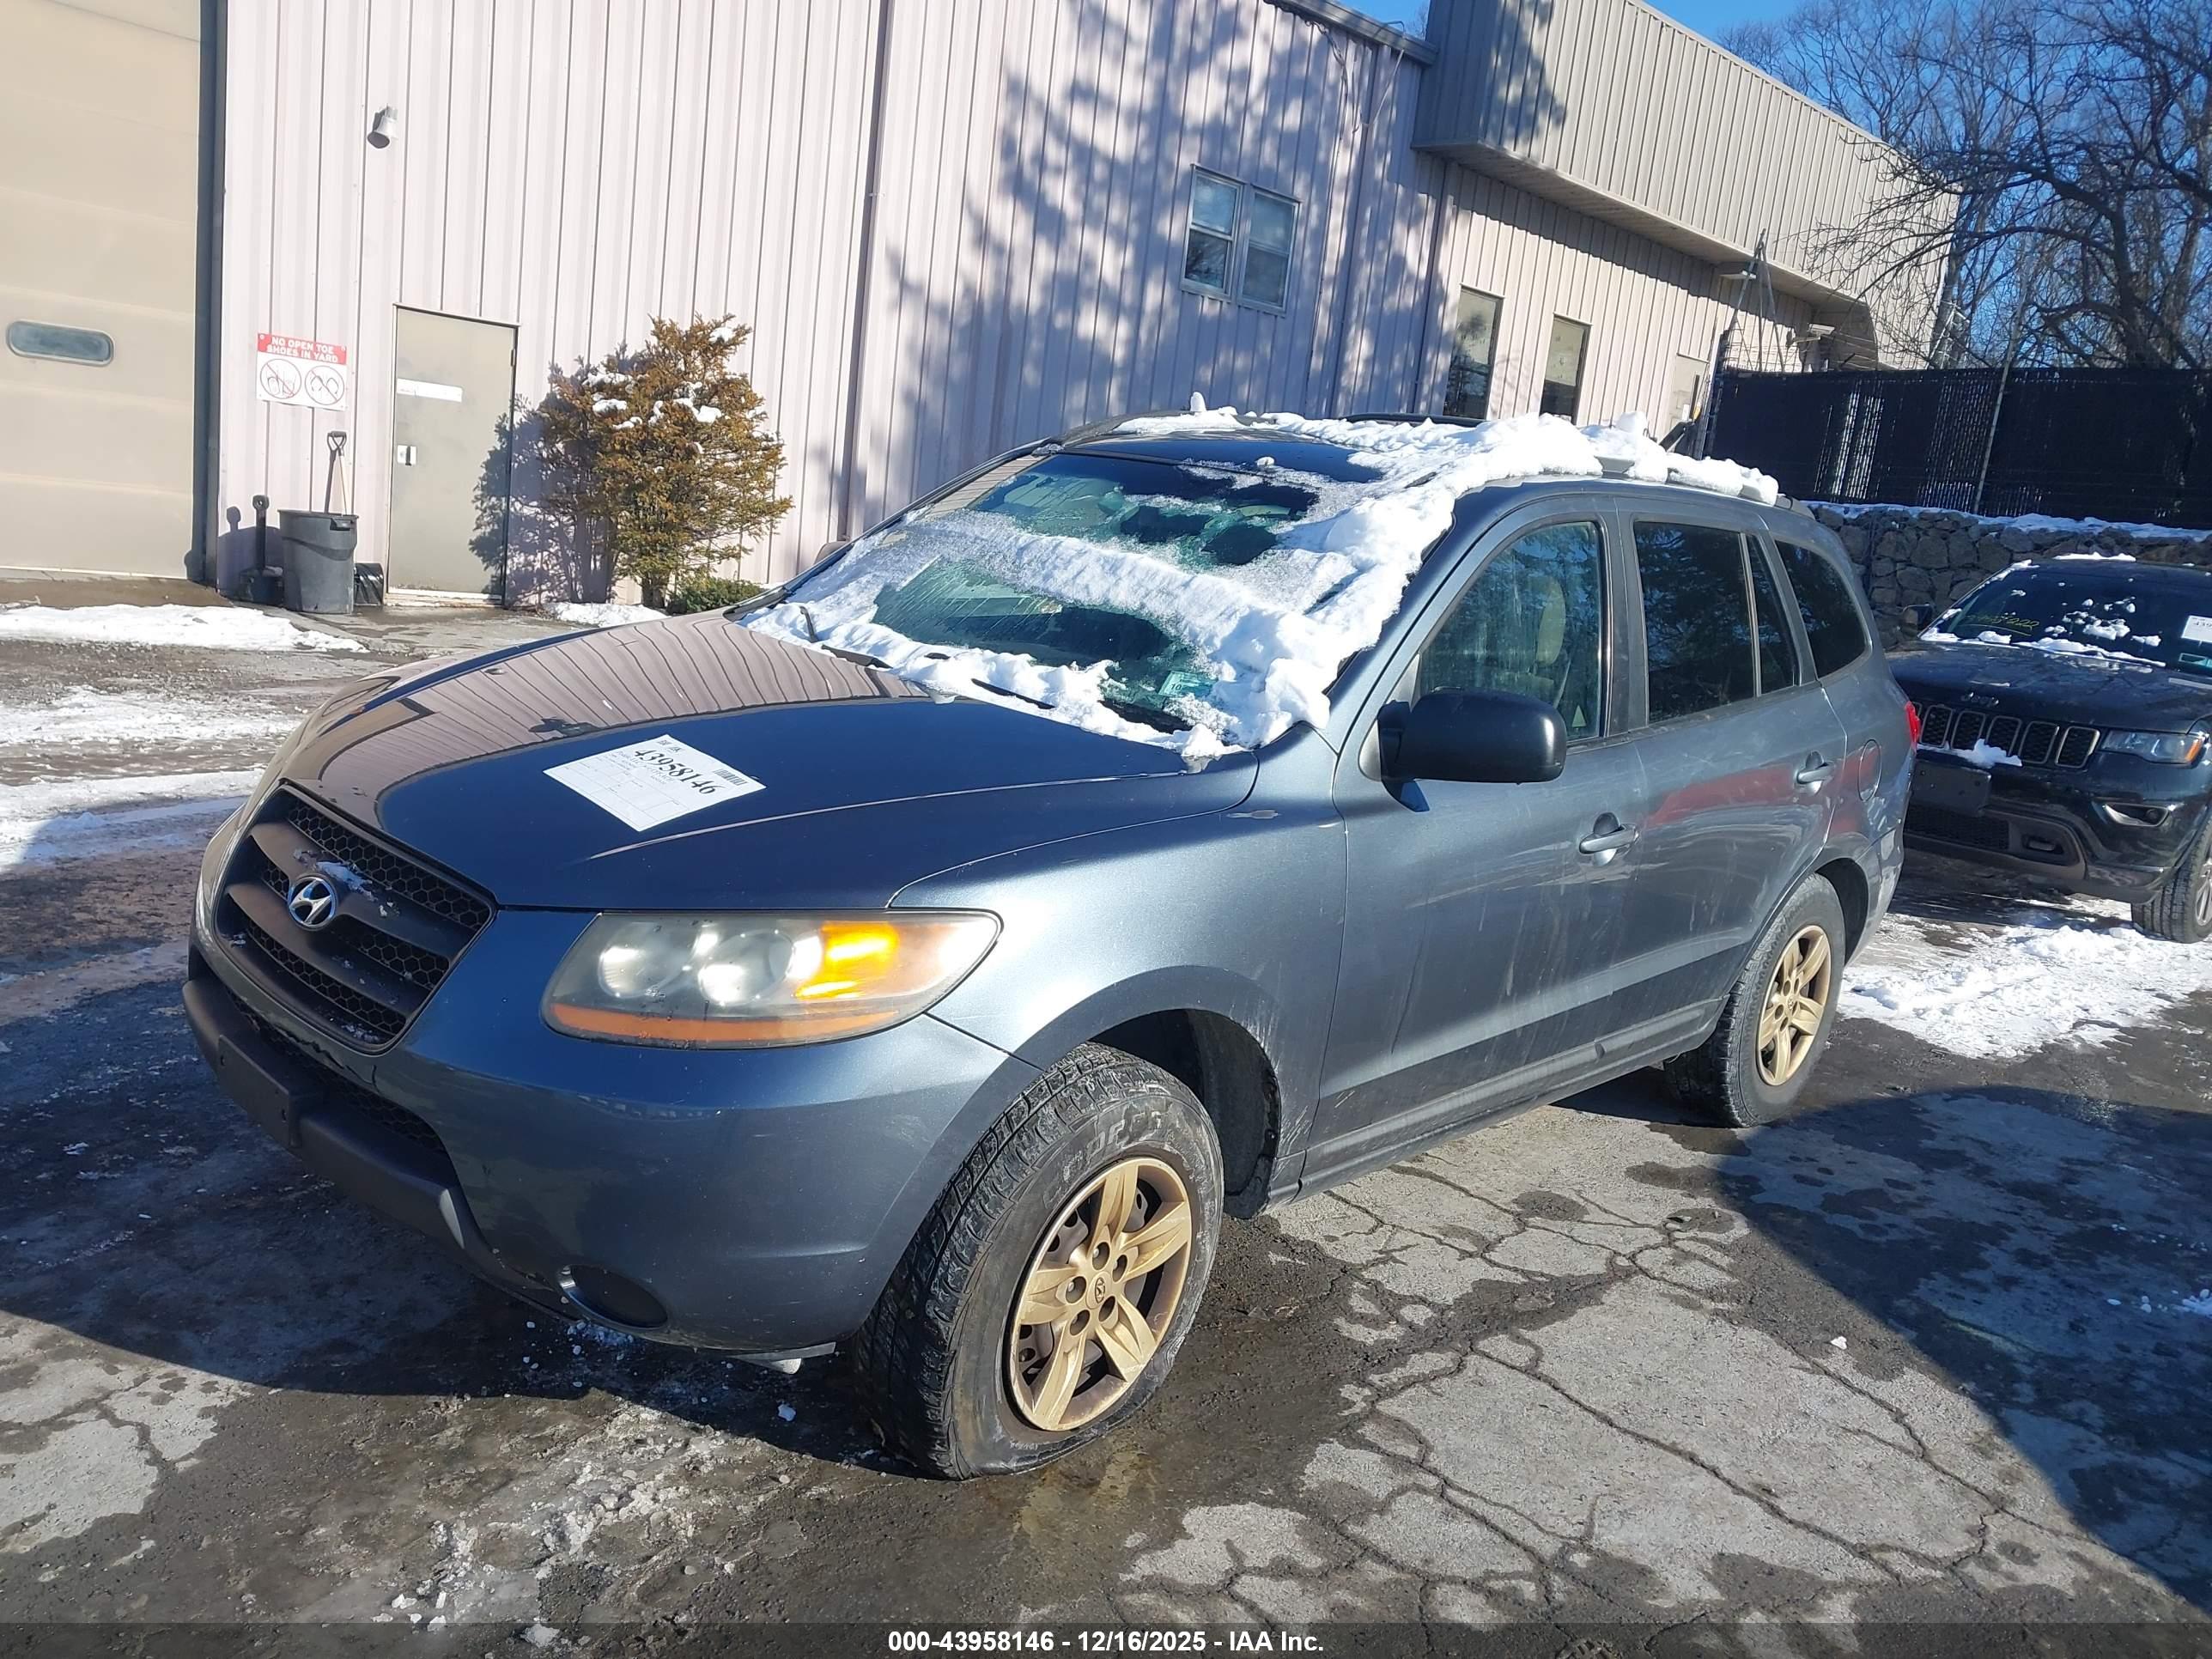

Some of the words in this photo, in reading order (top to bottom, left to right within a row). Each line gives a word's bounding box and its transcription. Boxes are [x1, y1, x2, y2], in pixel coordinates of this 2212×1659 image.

[266, 344, 298, 357] SHOES
[301, 349, 311, 358] IN
[313, 352, 338, 362] YARD
[271, 336, 286, 346] NO
[288, 339, 313, 351] OPEN
[315, 343, 334, 354] TOE
[635, 750, 726, 794] 43958146
